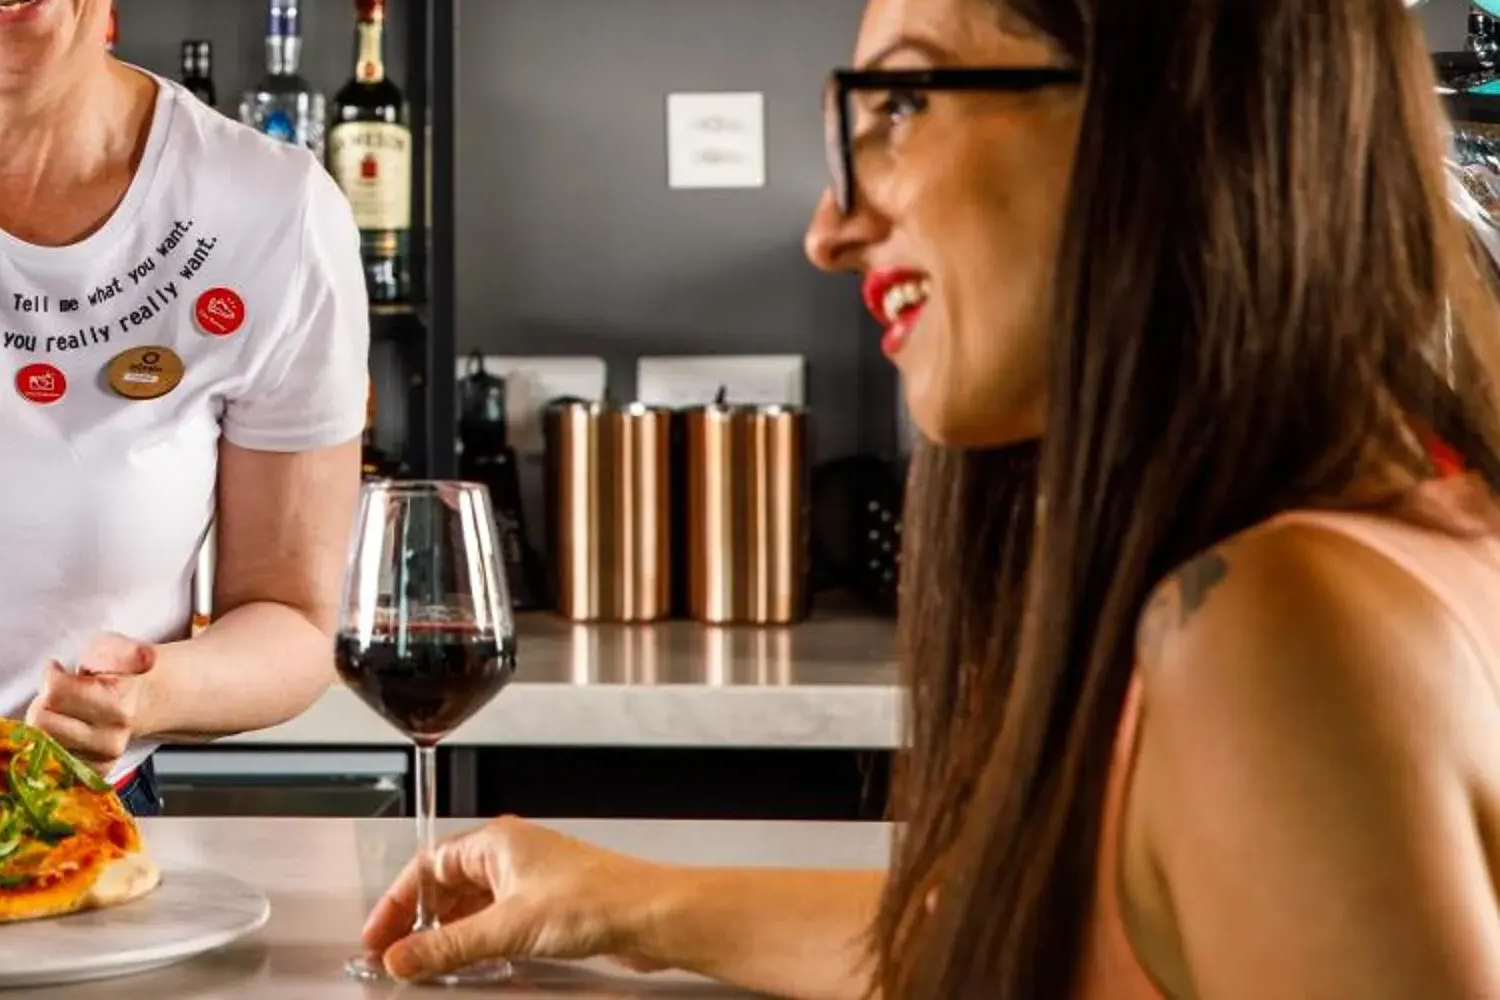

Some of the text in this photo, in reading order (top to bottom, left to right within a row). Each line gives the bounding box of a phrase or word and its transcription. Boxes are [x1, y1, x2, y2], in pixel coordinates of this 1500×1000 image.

[3, 331, 37, 352] you
[46, 325, 110, 353] really
[119, 281, 178, 333] really
[179, 237, 218, 280] want.
[13, 220, 194, 313] Tell me what you want.
